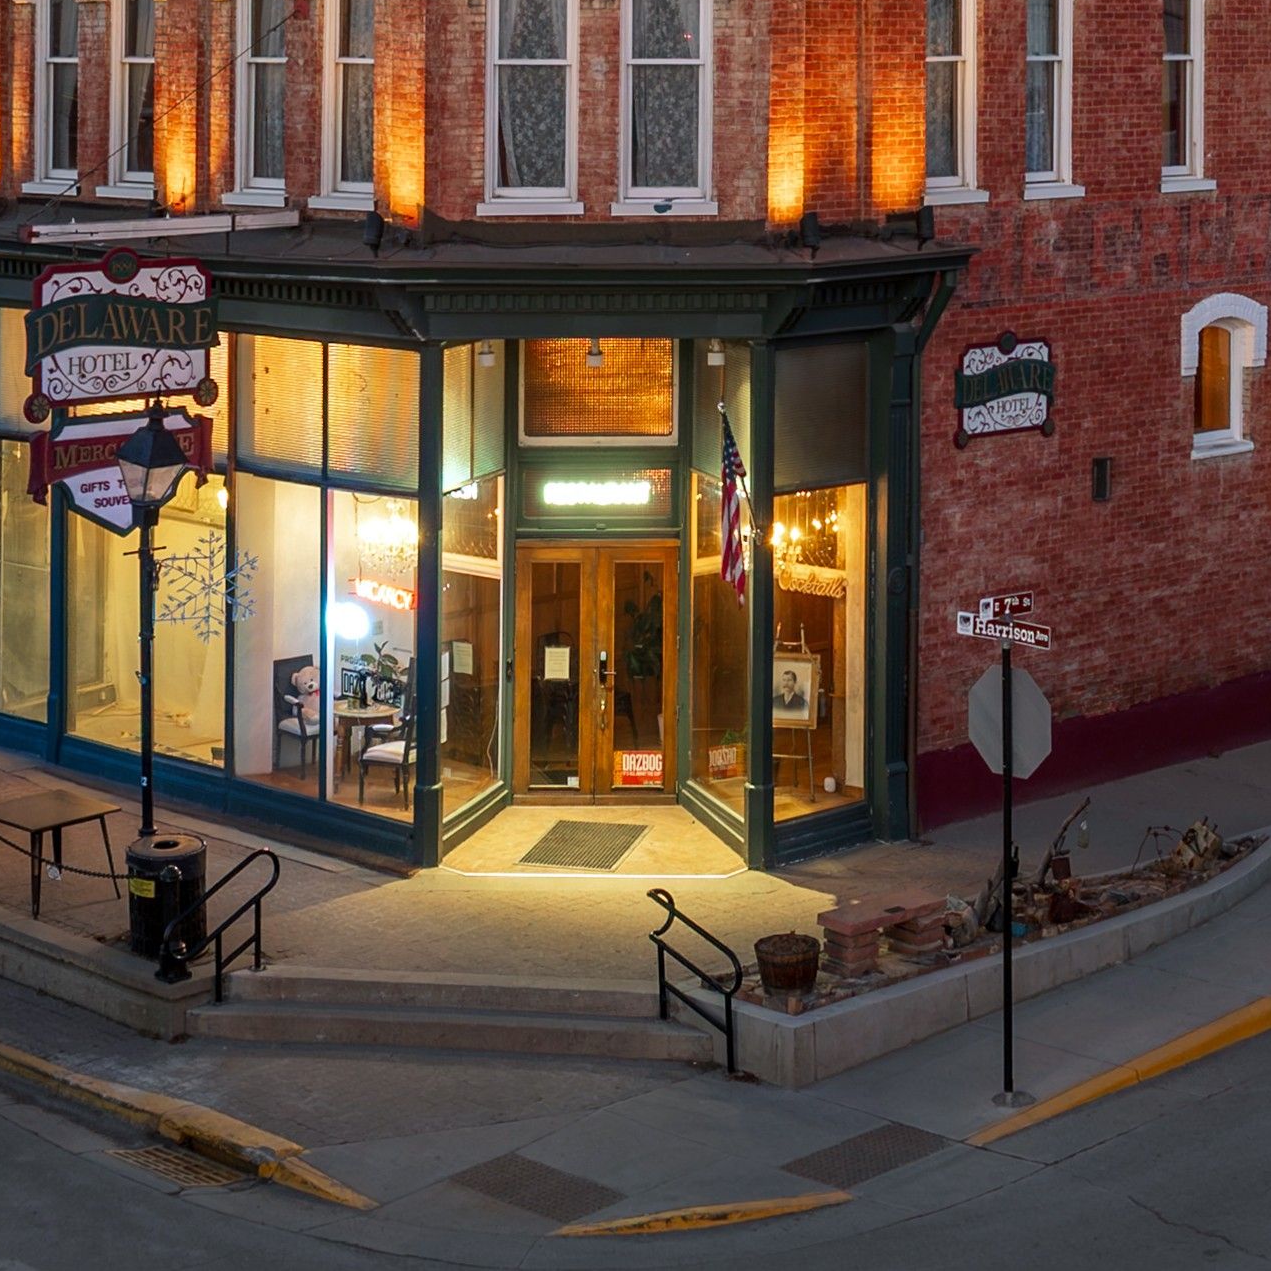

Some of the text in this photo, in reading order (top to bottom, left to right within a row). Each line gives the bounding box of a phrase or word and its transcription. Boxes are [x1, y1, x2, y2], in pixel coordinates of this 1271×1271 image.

[35, 303, 214, 355] DELAWARE
[68, 352, 138, 375] HOTEL
[962, 361, 1051, 404] DELAWARE
[996, 397, 1033, 414] HOTEL
[80, 480, 111, 494] GIFTS
[778, 569, 846, 598] Cocktails
[975, 618, 1049, 643] Harrison Ave
[622, 753, 663, 771] DAZBOG
